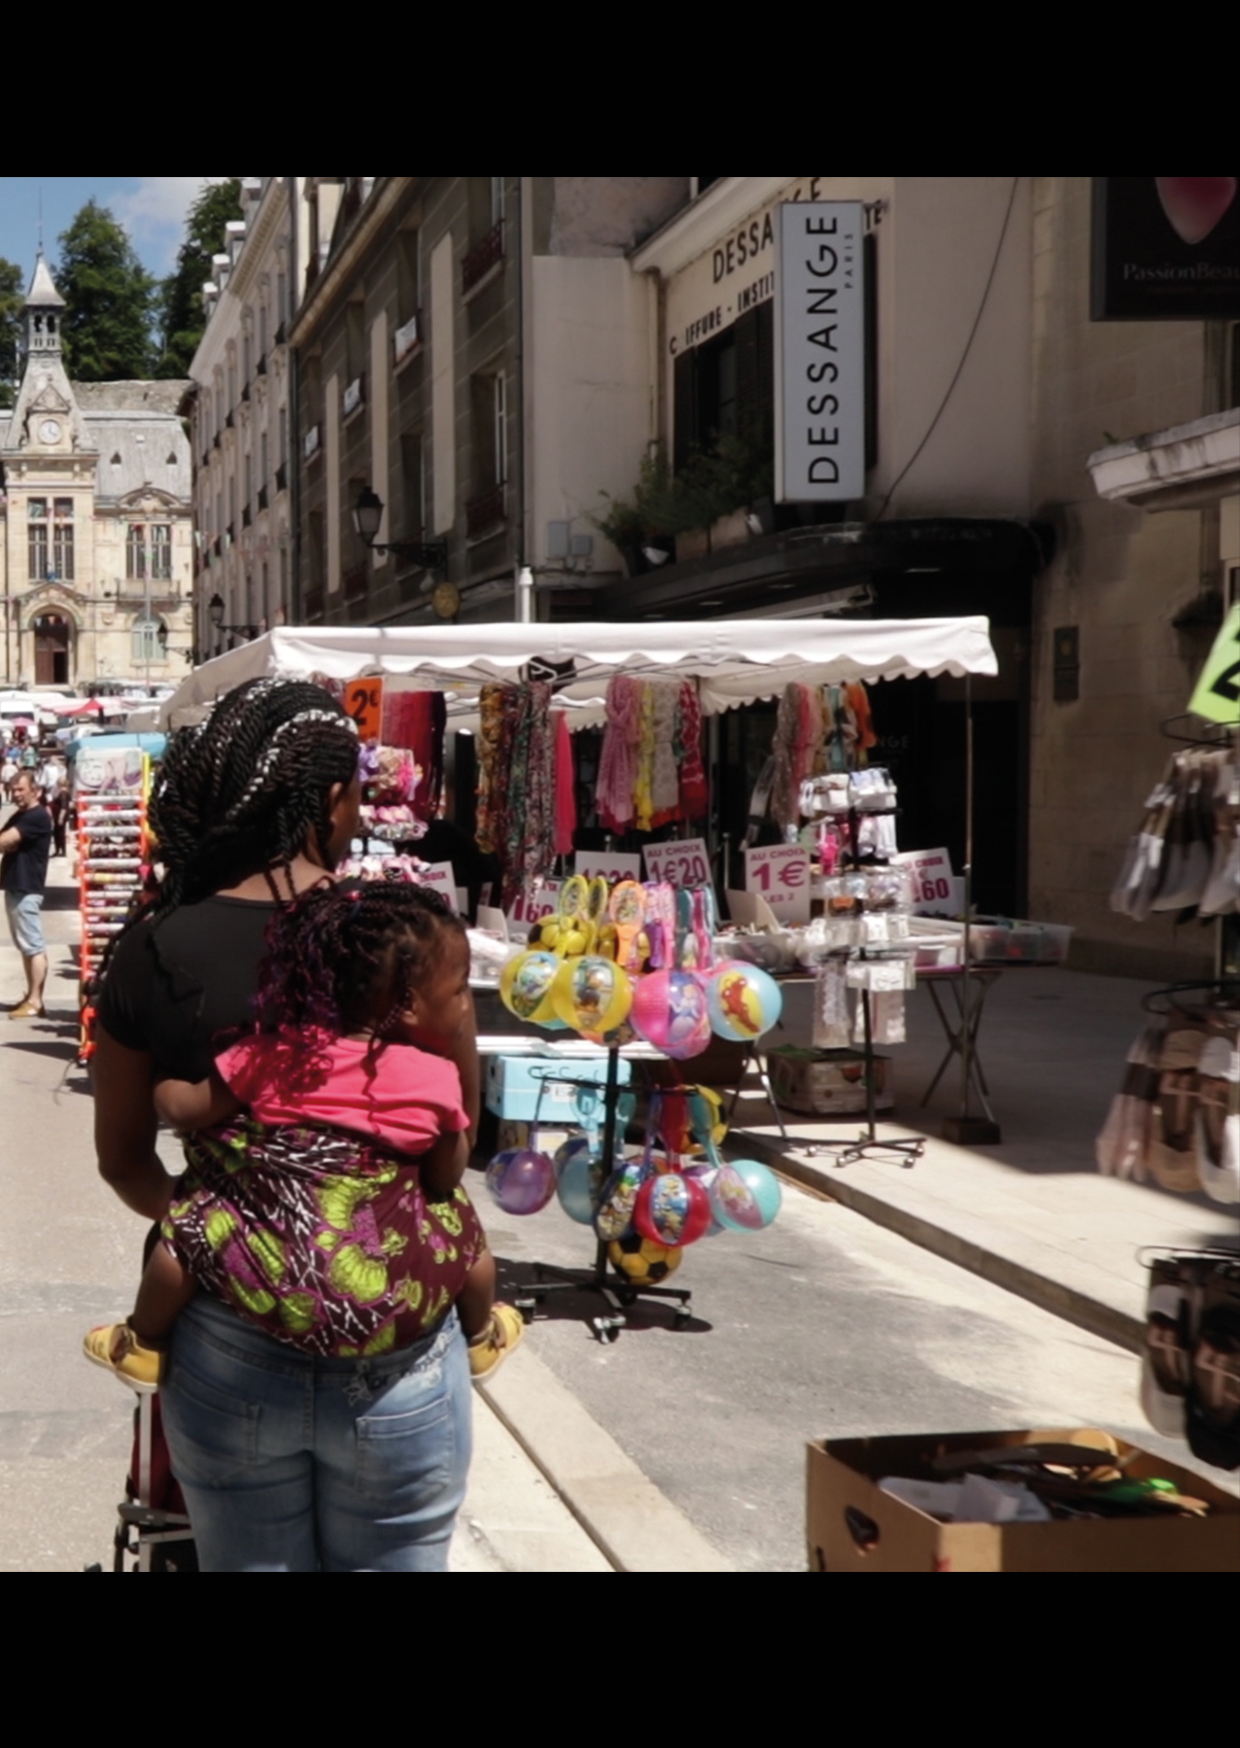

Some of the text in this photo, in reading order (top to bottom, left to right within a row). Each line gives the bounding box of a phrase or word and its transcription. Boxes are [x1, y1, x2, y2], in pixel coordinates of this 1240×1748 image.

[844, 233, 854, 290] PARIS
[806, 216, 840, 484] DESSANGE
[647, 844, 703, 858] AU CHOIX
[750, 848, 806, 862] AU CHOIX
[650, 855, 707, 886] 1€20
